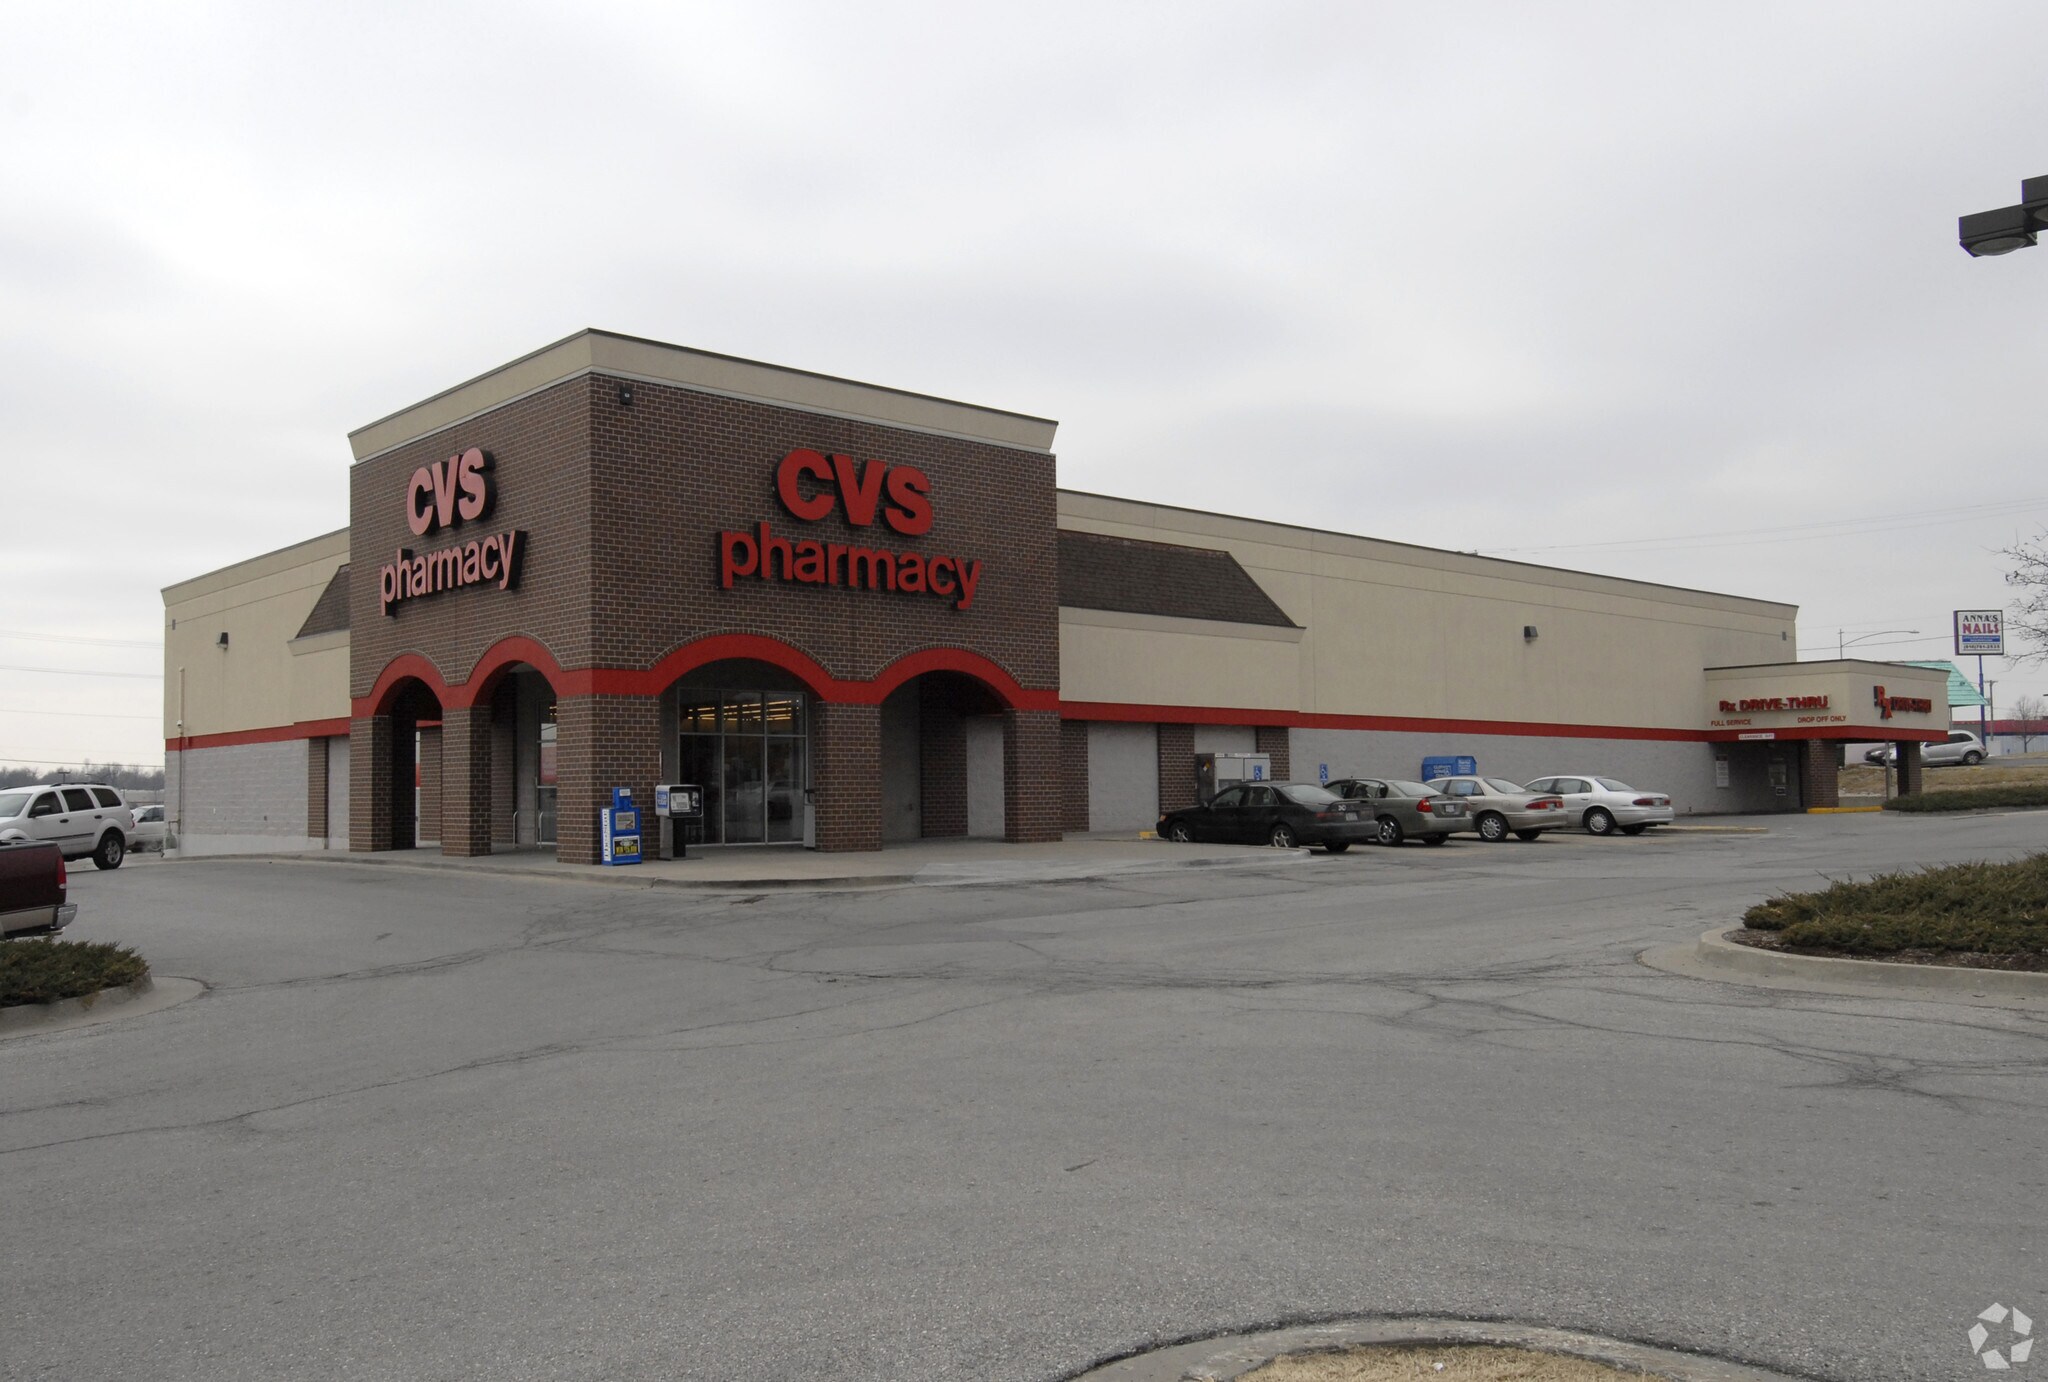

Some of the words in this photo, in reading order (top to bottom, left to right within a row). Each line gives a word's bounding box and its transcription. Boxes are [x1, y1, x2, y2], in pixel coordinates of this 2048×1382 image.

[407, 448, 488, 536] CVS
[776, 448, 933, 536] CVS
[381, 530, 519, 617] pharmacy
[720, 521, 983, 610] pharmacy
[1962, 614, 1999, 623] ANNA'S
[1962, 623, 1999, 634] NAILS
[1740, 695, 1829, 712] DRIVE-THRU
[1710, 719, 1725, 727] FULL
[1726, 718, 1752, 727] SERVICE
[1797, 716, 1815, 724] DROP
[1816, 715, 1829, 723] OFF
[1830, 714, 1847, 722] ONLY
